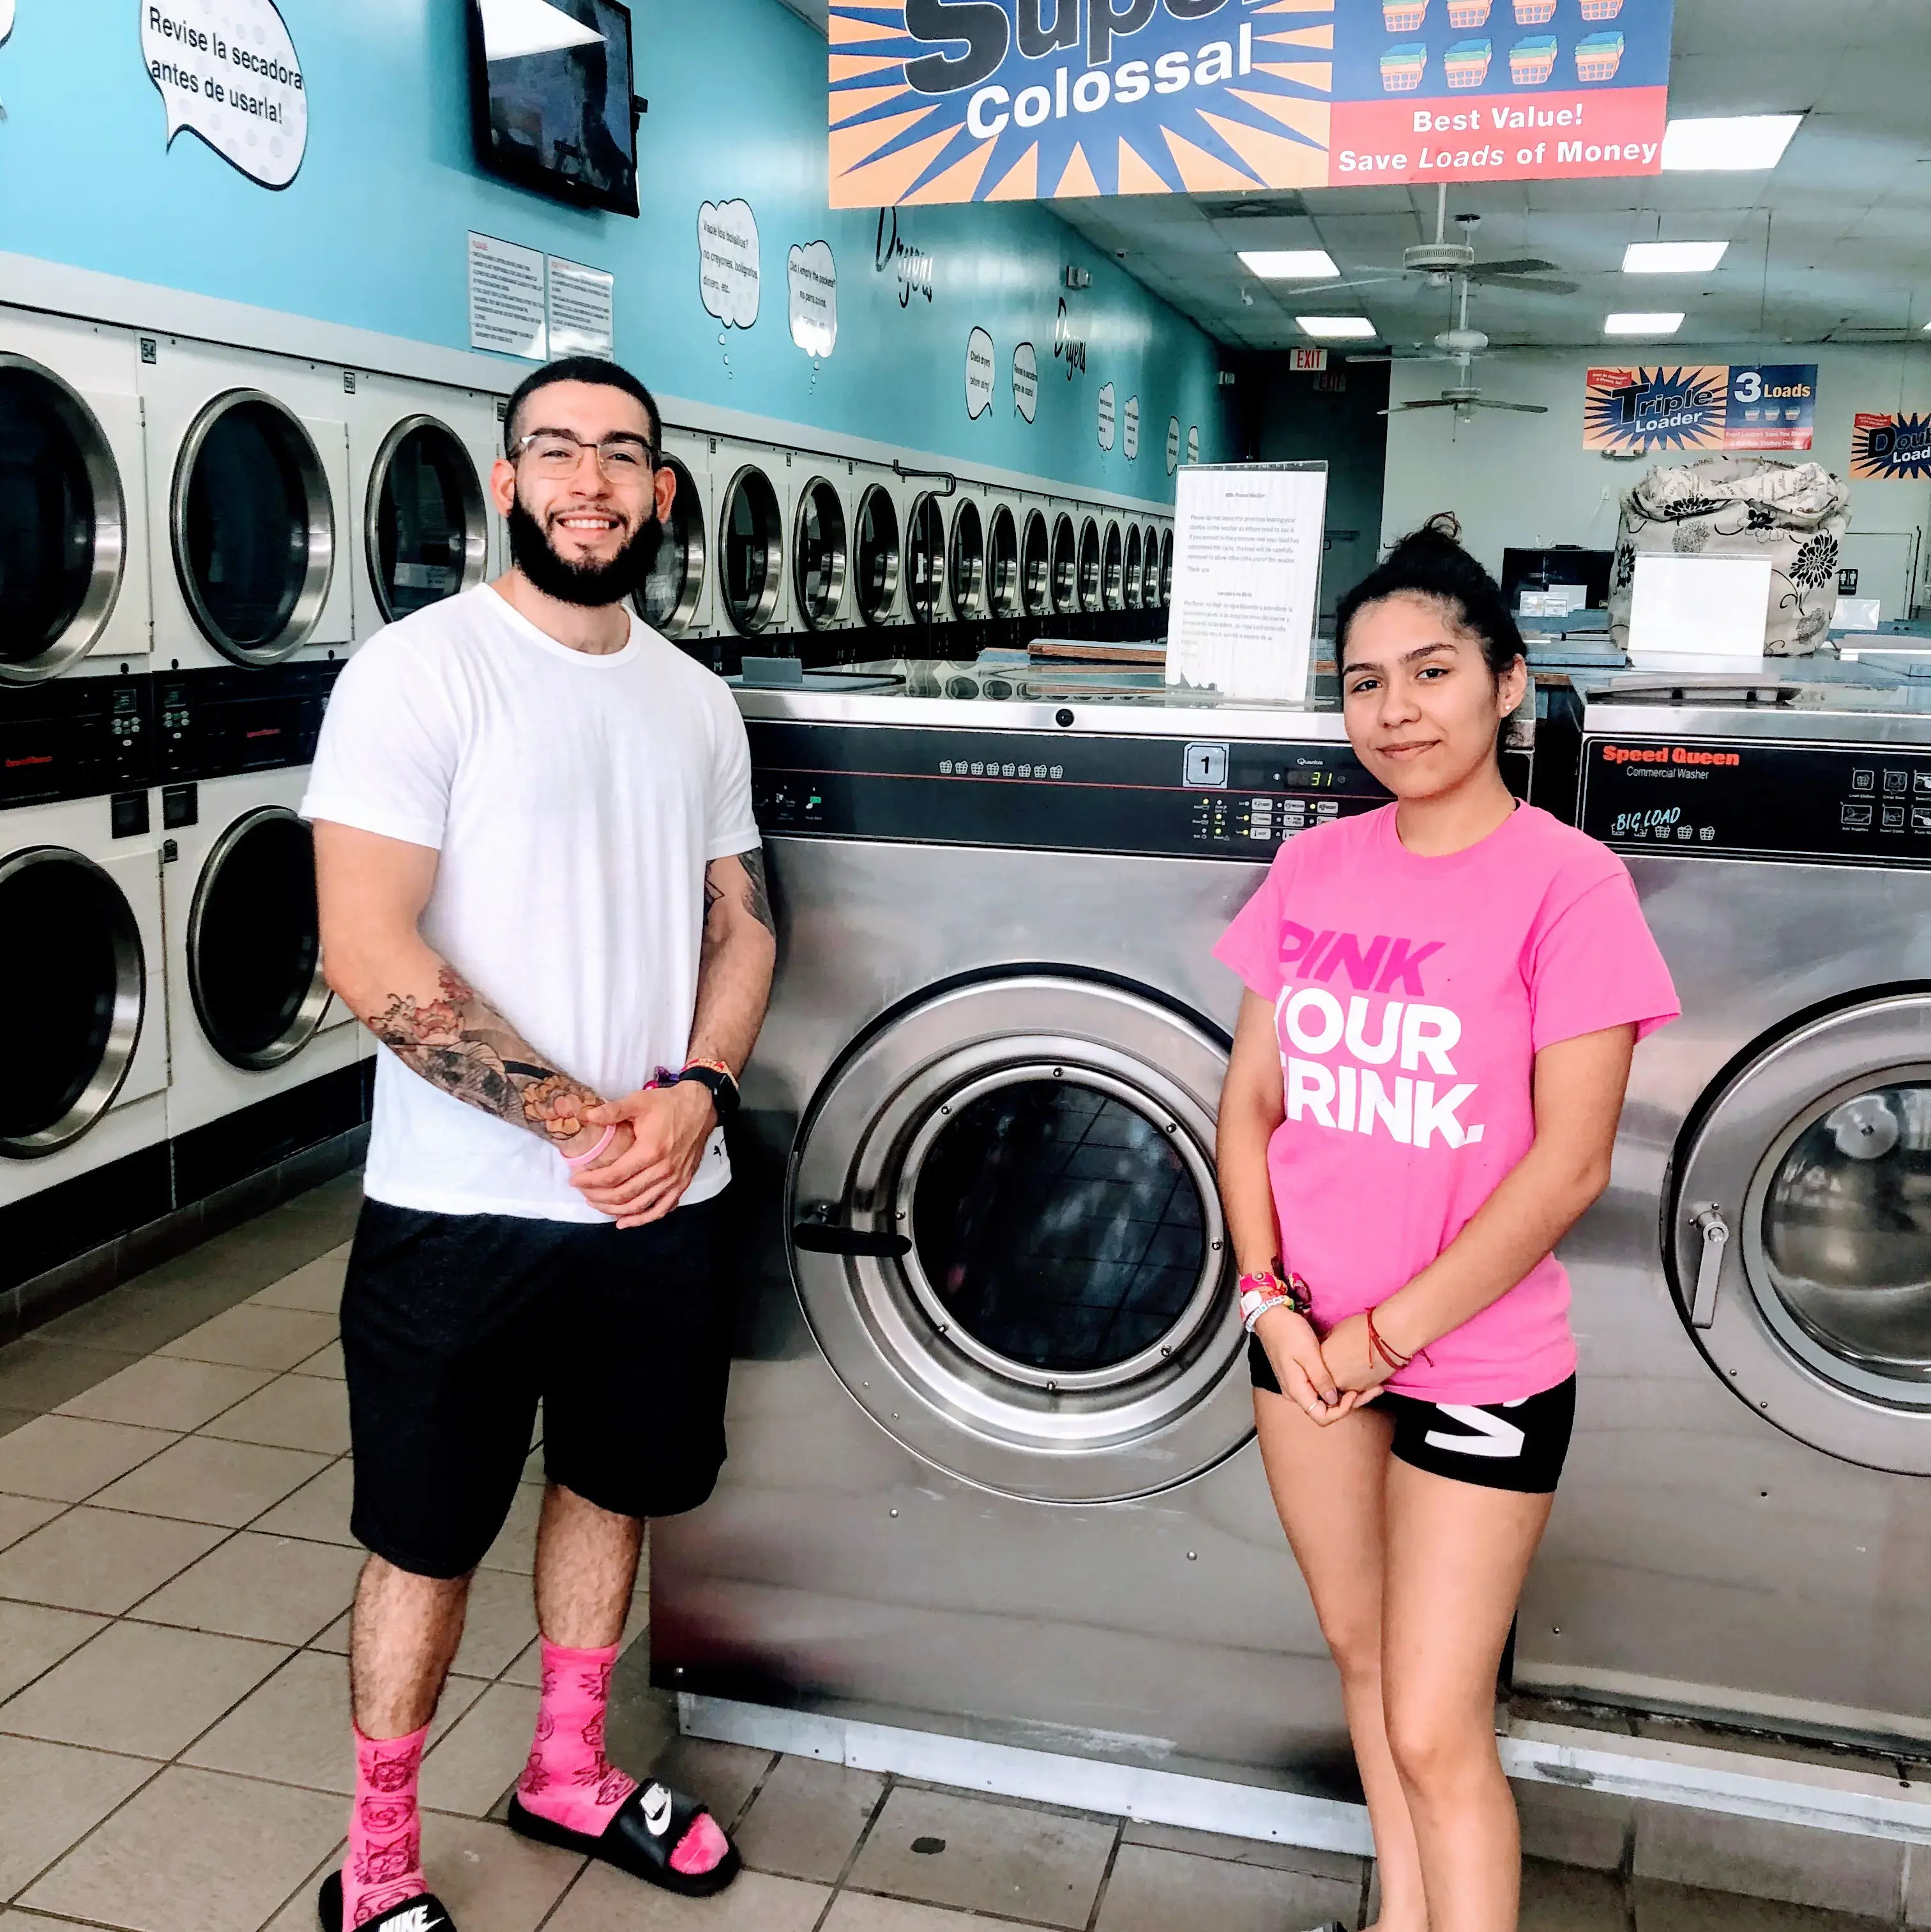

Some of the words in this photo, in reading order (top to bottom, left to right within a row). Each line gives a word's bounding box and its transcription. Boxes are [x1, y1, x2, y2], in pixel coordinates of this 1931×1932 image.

[150, 7, 208, 52] Revise
[213, 33, 227, 59] la
[232, 47, 303, 91] secadora
[903, 0, 1264, 95] Sup
[151, 59, 199, 93] antes
[204, 76, 224, 102] de
[230, 91, 282, 124] usarla!
[967, 22, 1253, 139] Colossal
[1412, 109, 1481, 133] Best
[1490, 103, 1584, 129] Value!
[1338, 149, 1408, 172] Save
[1418, 144, 1505, 169] Loads
[1516, 142, 1546, 164] of
[1557, 141, 1658, 165] Money
[1297, 350, 1321, 369] EXIT
[1734, 372, 1762, 403] 3
[1764, 383, 1811, 398] Loads
[1611, 383, 1713, 425] Triple
[1635, 412, 1703, 433] Loader
[1201, 756, 1210, 775] 1
[1603, 745, 1669, 764] Speed
[1672, 747, 1740, 766] Queen
[1311, 772, 1333, 786] 31
[1626, 766, 1676, 779] Commercial
[1677, 768, 1709, 780] Washer
[1616, 811, 1642, 833] BIG
[1644, 807, 1681, 827] LOAD
[1278, 920, 1446, 996] PINK
[1280, 1051, 1485, 1150] RINK.
